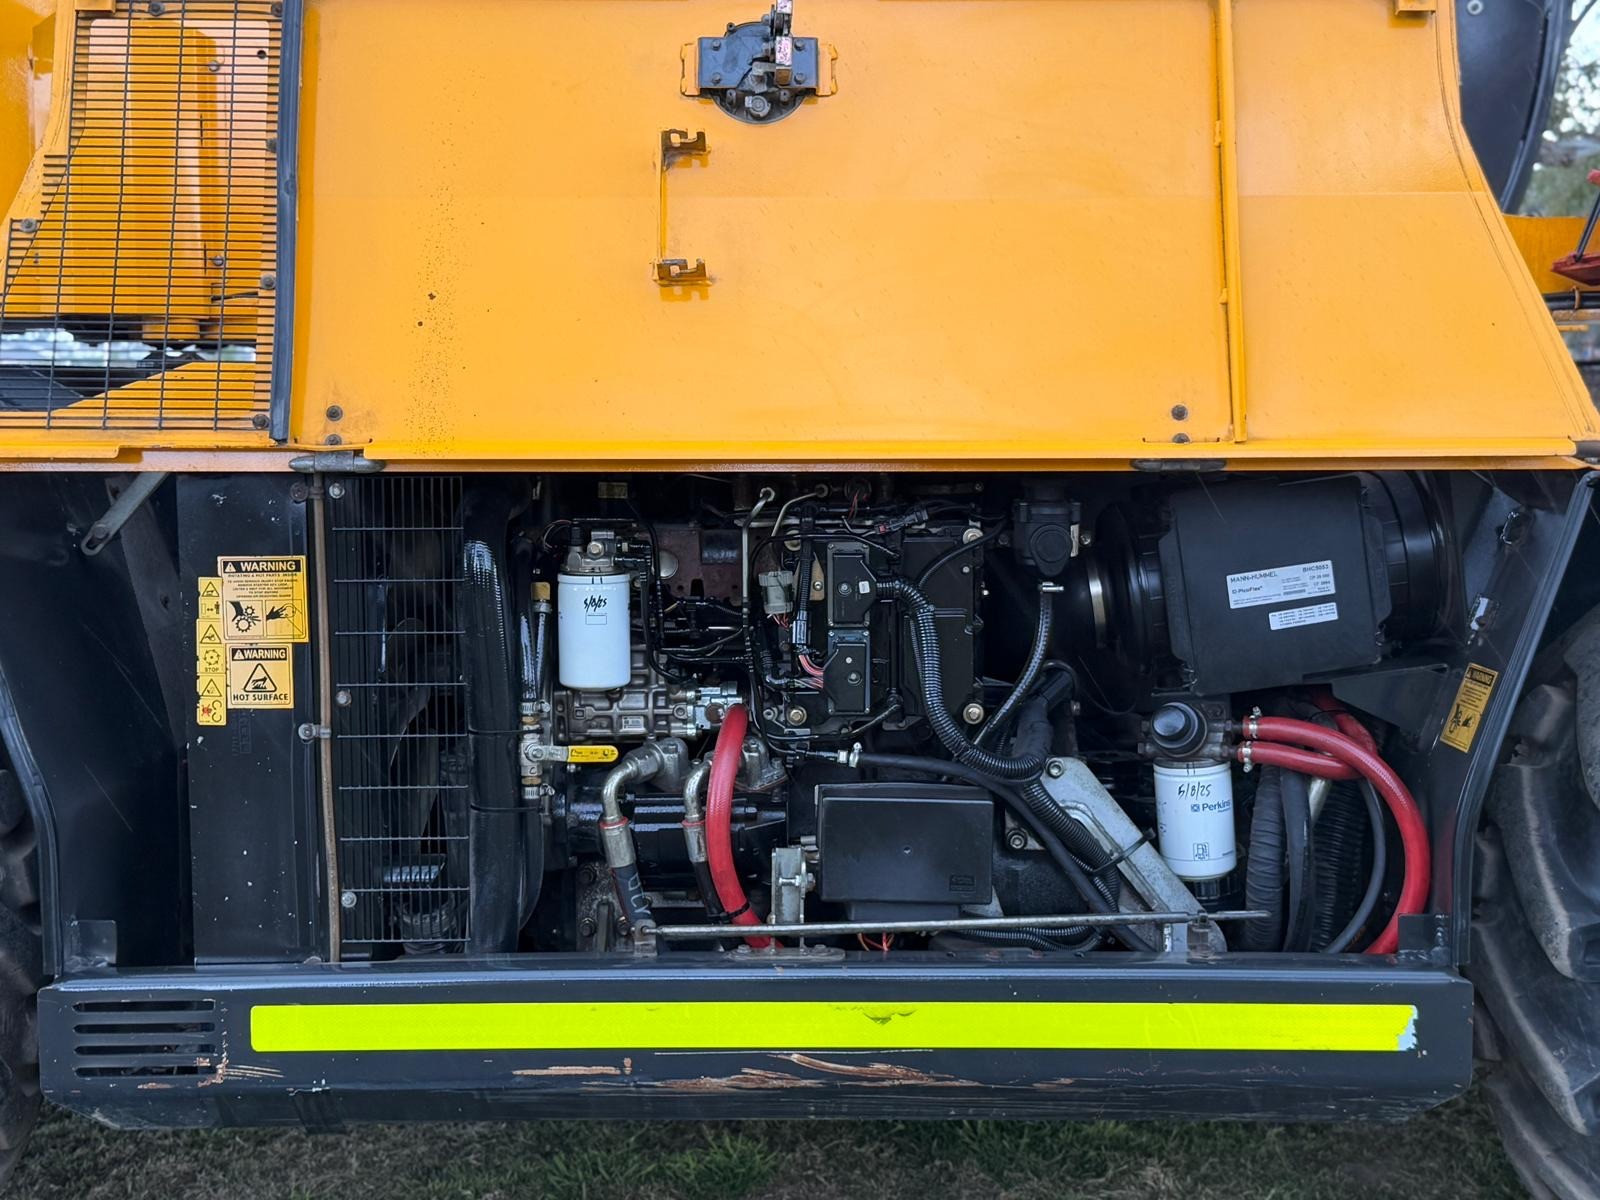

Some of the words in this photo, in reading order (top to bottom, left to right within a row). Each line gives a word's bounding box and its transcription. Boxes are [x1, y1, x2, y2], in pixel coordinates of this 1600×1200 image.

[240, 561, 296, 572] WARNING
[243, 649, 286, 659] WARNING
[233, 693, 250, 701] HOT
[252, 693, 289, 701] SURFACE
[1178, 782, 1212, 800] 5/8/25
